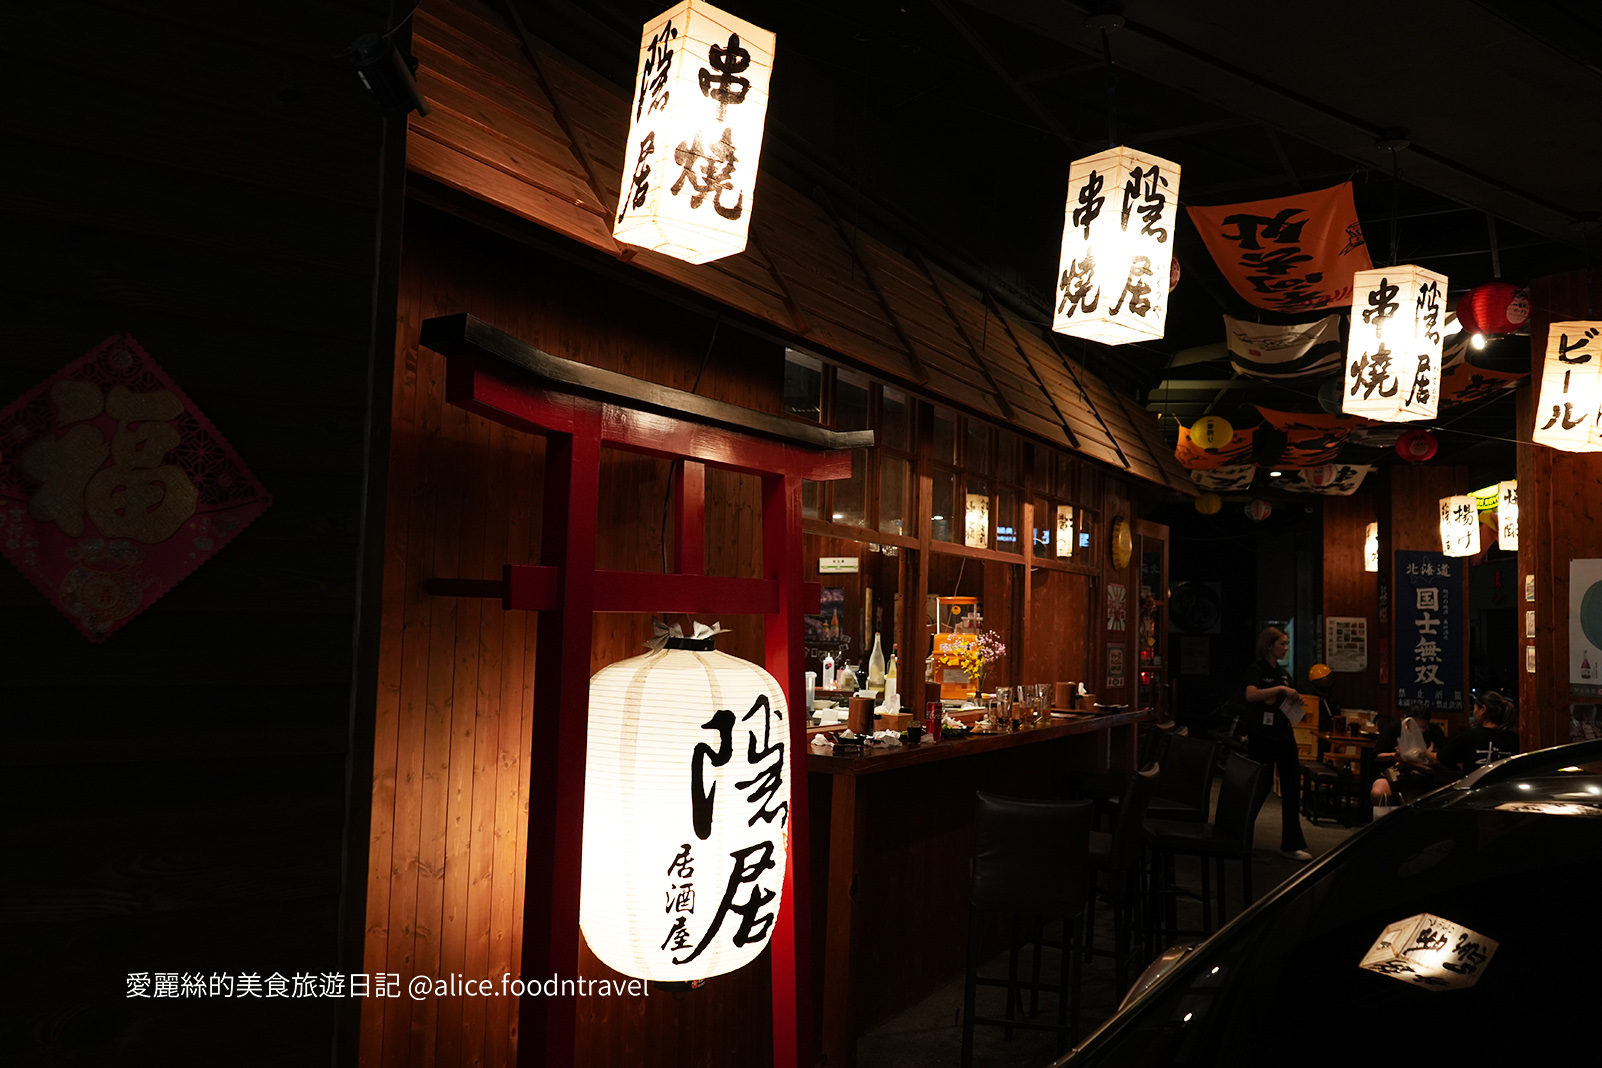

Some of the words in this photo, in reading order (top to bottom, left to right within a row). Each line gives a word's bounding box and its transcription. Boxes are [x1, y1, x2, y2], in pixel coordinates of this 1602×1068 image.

[1540, 327, 1600, 431] ビール
[1406, 562, 1452, 578] 北海道
[1453, 503, 1477, 550] 揚げ
[1413, 586, 1445, 686] 国士無双
[660, 843, 696, 951] 居酒屋
